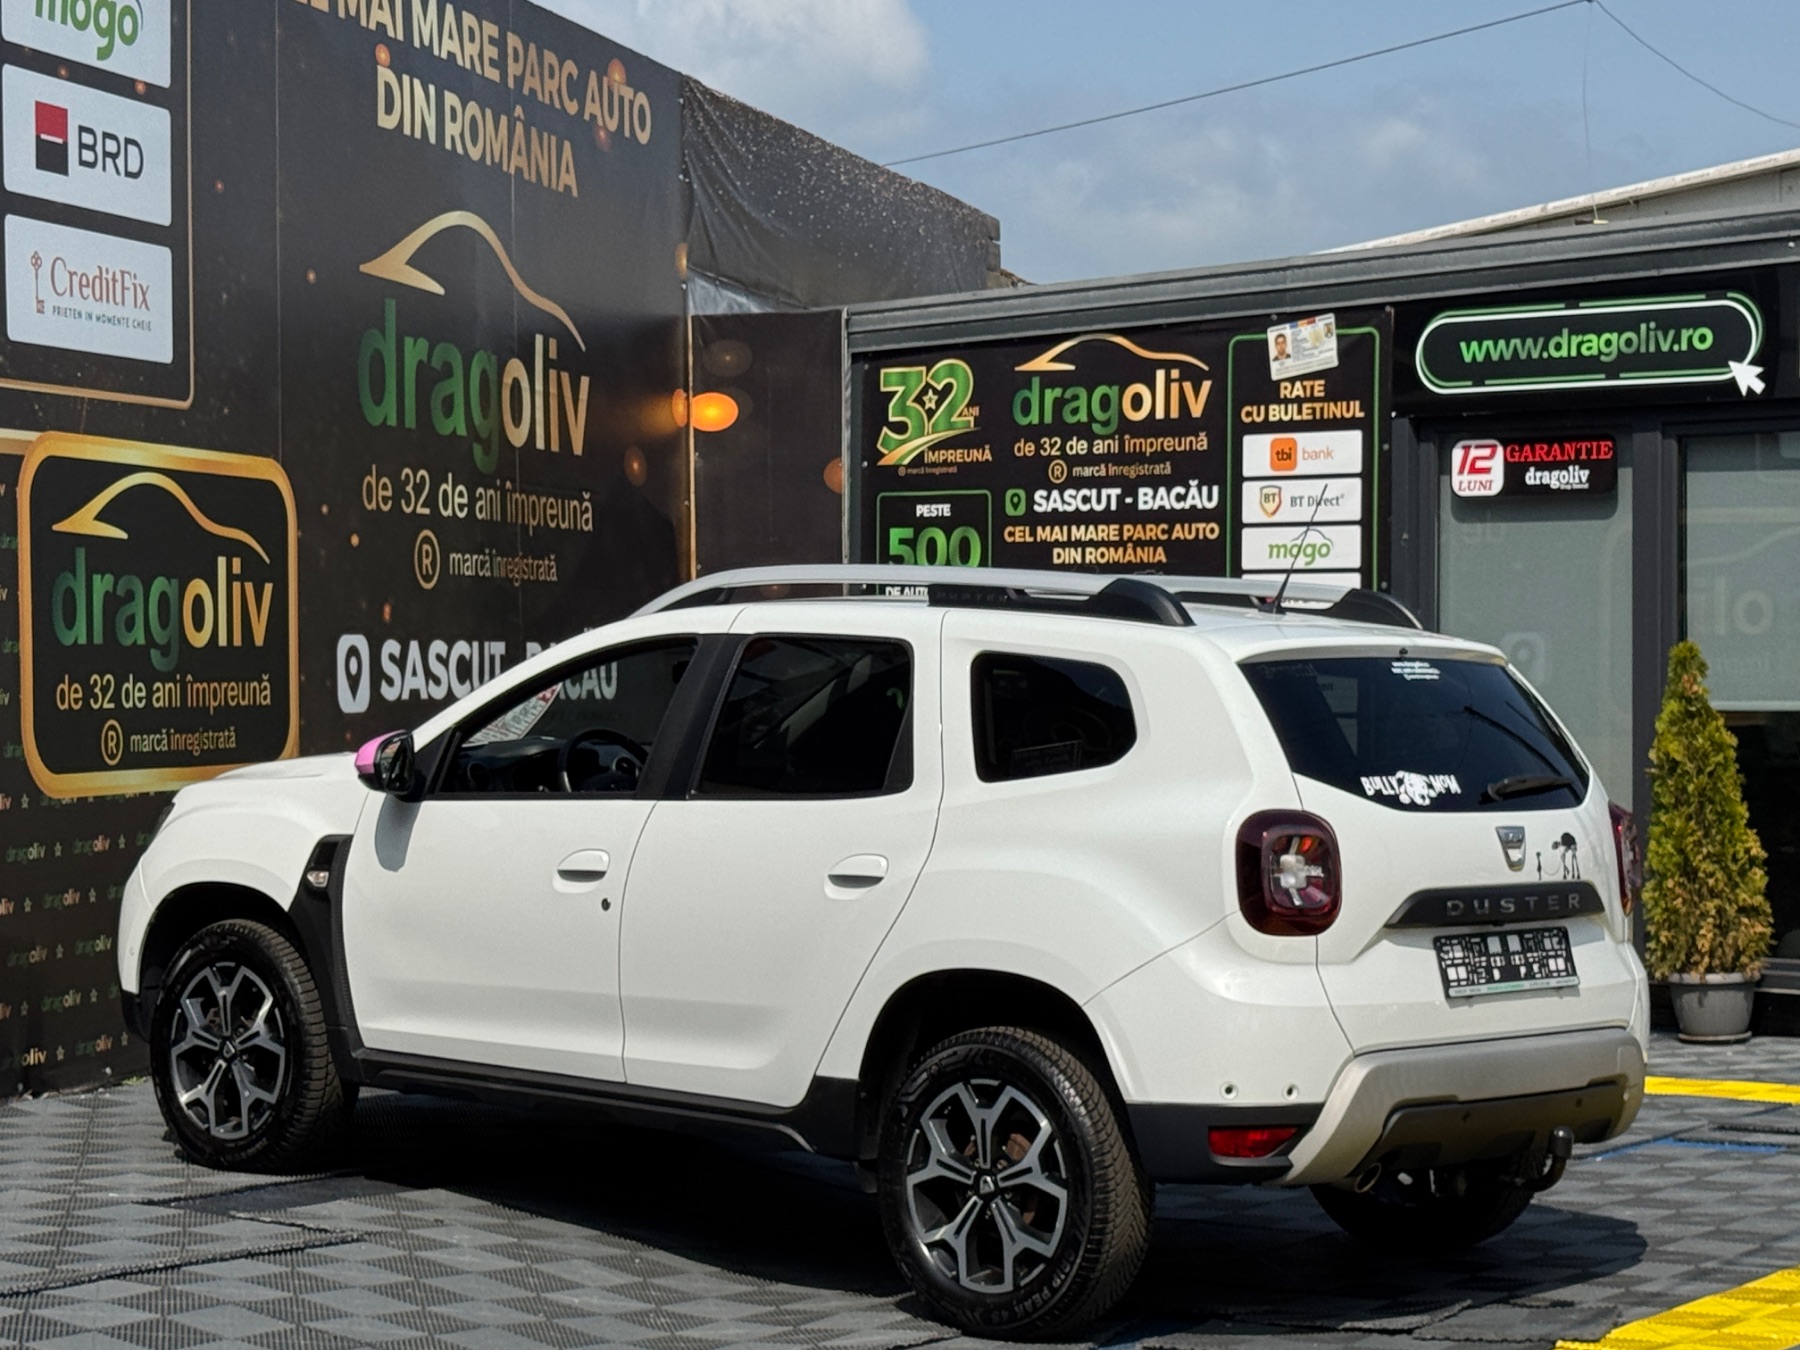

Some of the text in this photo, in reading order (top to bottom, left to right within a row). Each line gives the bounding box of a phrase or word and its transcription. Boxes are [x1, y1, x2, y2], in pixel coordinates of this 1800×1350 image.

[35, 0, 139, 61] mogo
[412, 0, 500, 83] MARE
[507, 31, 579, 116] PARC
[584, 70, 652, 145] AUTO
[377, 64, 579, 198] DIN ROMÂNIA
[78, 125, 144, 180] BRD
[50, 256, 150, 312] CreditFix
[1459, 322, 1714, 363] www.dragoliv.ro
[358, 298, 590, 474] dragoliv
[1280, 380, 1325, 399] RATE
[877, 358, 974, 455] 32
[1012, 369, 1213, 435] dragoliv
[1241, 400, 1364, 423] CU BULETINUL
[1014, 431, 1208, 457] de 32 de ani împreună
[1275, 446, 1334, 461] tbi bank
[1506, 441, 1614, 462] GARANTIE
[1072, 462, 1107, 477] marcă
[1108, 461, 1172, 480] înregistrată
[1457, 444, 1497, 476] 12
[1458, 479, 1494, 493] LUNI
[1525, 465, 1590, 489] dragoliv
[363, 464, 593, 536] de 32 de ani împreună
[916, 504, 952, 517] PESTE
[1033, 488, 1122, 513] SASCUT
[1137, 479, 1220, 511] BACĂU
[1264, 492, 1277, 504] BT
[1290, 496, 1304, 508] BT
[889, 526, 982, 568] 500
[1004, 522, 1220, 543] CEL MAI MARE PARC AUTO
[449, 547, 490, 577] marcă
[492, 551, 558, 587] înregistrată
[1053, 543, 1166, 564] DIN ROMÂNIA
[1268, 540, 1332, 566] mogo
[903, 586, 929, 597] AUT
[52, 546, 274, 672] dragoliv
[380, 638, 506, 701] SASCUT
[56, 673, 271, 714] de 32 de ani împreună
[130, 728, 169, 753] marcă
[169, 726, 236, 756] înregistrată
[1446, 893, 1580, 917] DUSTER
